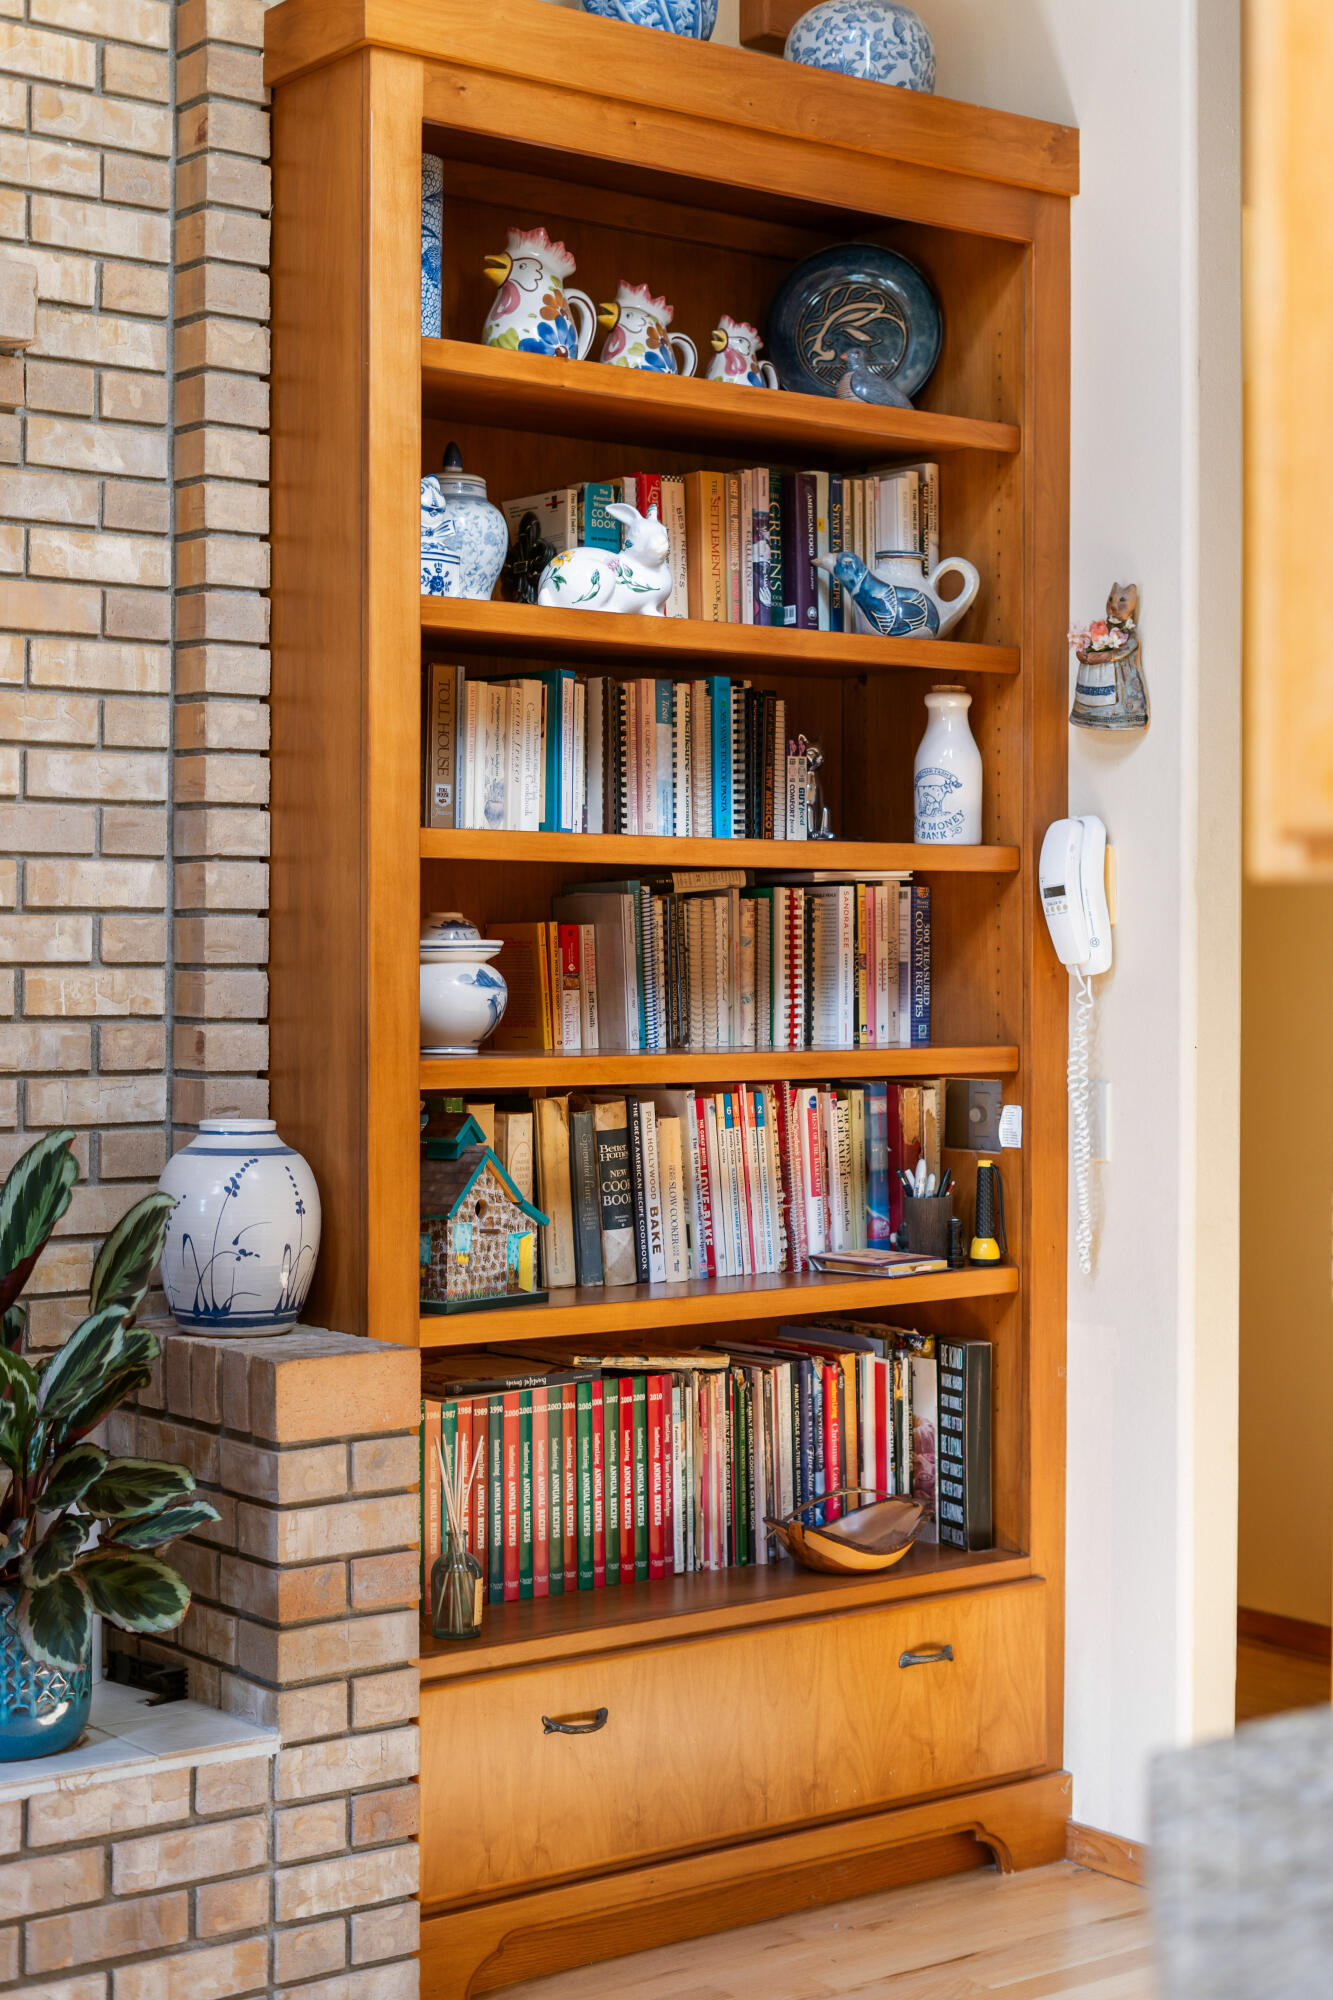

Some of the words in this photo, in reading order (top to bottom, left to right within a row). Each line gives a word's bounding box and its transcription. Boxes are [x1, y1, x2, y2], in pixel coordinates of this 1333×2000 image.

[592, 519, 616, 528] BOOK
[832, 503, 841, 536] STATE
[710, 496, 721, 580] SETTLEMENT
[769, 502, 782, 591] GREENS
[679, 540, 687, 588] RECIPES
[438, 679, 450, 719] TOLL
[662, 688, 669, 697] A
[662, 700, 670, 722] Taste
[438, 722, 450, 776] HOUSE
[720, 726, 728, 750] WAYS
[720, 785, 728, 812] PASTA
[921, 831, 948, 840] BANK
[928, 810, 964, 831] MONEY
[916, 911, 924, 968] COUNTRY
[916, 968, 924, 1018] RECIPES
[564, 994, 573, 1046] Cookbook
[727, 1106, 732, 1114] 6
[758, 1106, 763, 1114] 2
[600, 1144, 626, 1152] Better
[610, 1168, 627, 1178] NEW
[646, 1138, 656, 1200] HOLLYWOOD
[668, 1182, 677, 1208] SLOW
[700, 1169, 710, 1204] LOVE
[650, 1206, 662, 1254] BAKE
[670, 1209, 678, 1244] COOKER
[703, 1210, 713, 1246] BAKE
[640, 1220, 648, 1270] COOKBOOK
[698, 1230, 706, 1258] recipes
[941, 1344, 948, 1367] BE
[474, 1408, 488, 1417] 1989
[548, 1402, 561, 1410] 2003
[578, 1402, 592, 1410] 2005
[606, 1396, 618, 1404] 2007
[620, 1396, 632, 1404] 2008
[633, 1394, 645, 1402] 2009
[650, 1393, 662, 1401] 2010
[624, 1465, 632, 1496] ANNUAL
[654, 1462, 662, 1493] ANNUAL
[806, 1445, 815, 1490] Five-Star
[508, 1480, 516, 1512] ANNUAL
[552, 1473, 560, 1504] ANNUAL
[566, 1472, 574, 1503] ANNUAL
[594, 1468, 602, 1499] ANNUAL
[538, 1510, 546, 1541] RECIPES
[566, 1505, 574, 1537] RECIPES
[610, 1498, 618, 1529] RECIPES
[624, 1498, 632, 1530] RECIPES
[654, 1495, 662, 1526] RECIPES
[494, 1515, 502, 1546] RECIPES
[508, 1514, 516, 1546] RECIPES
